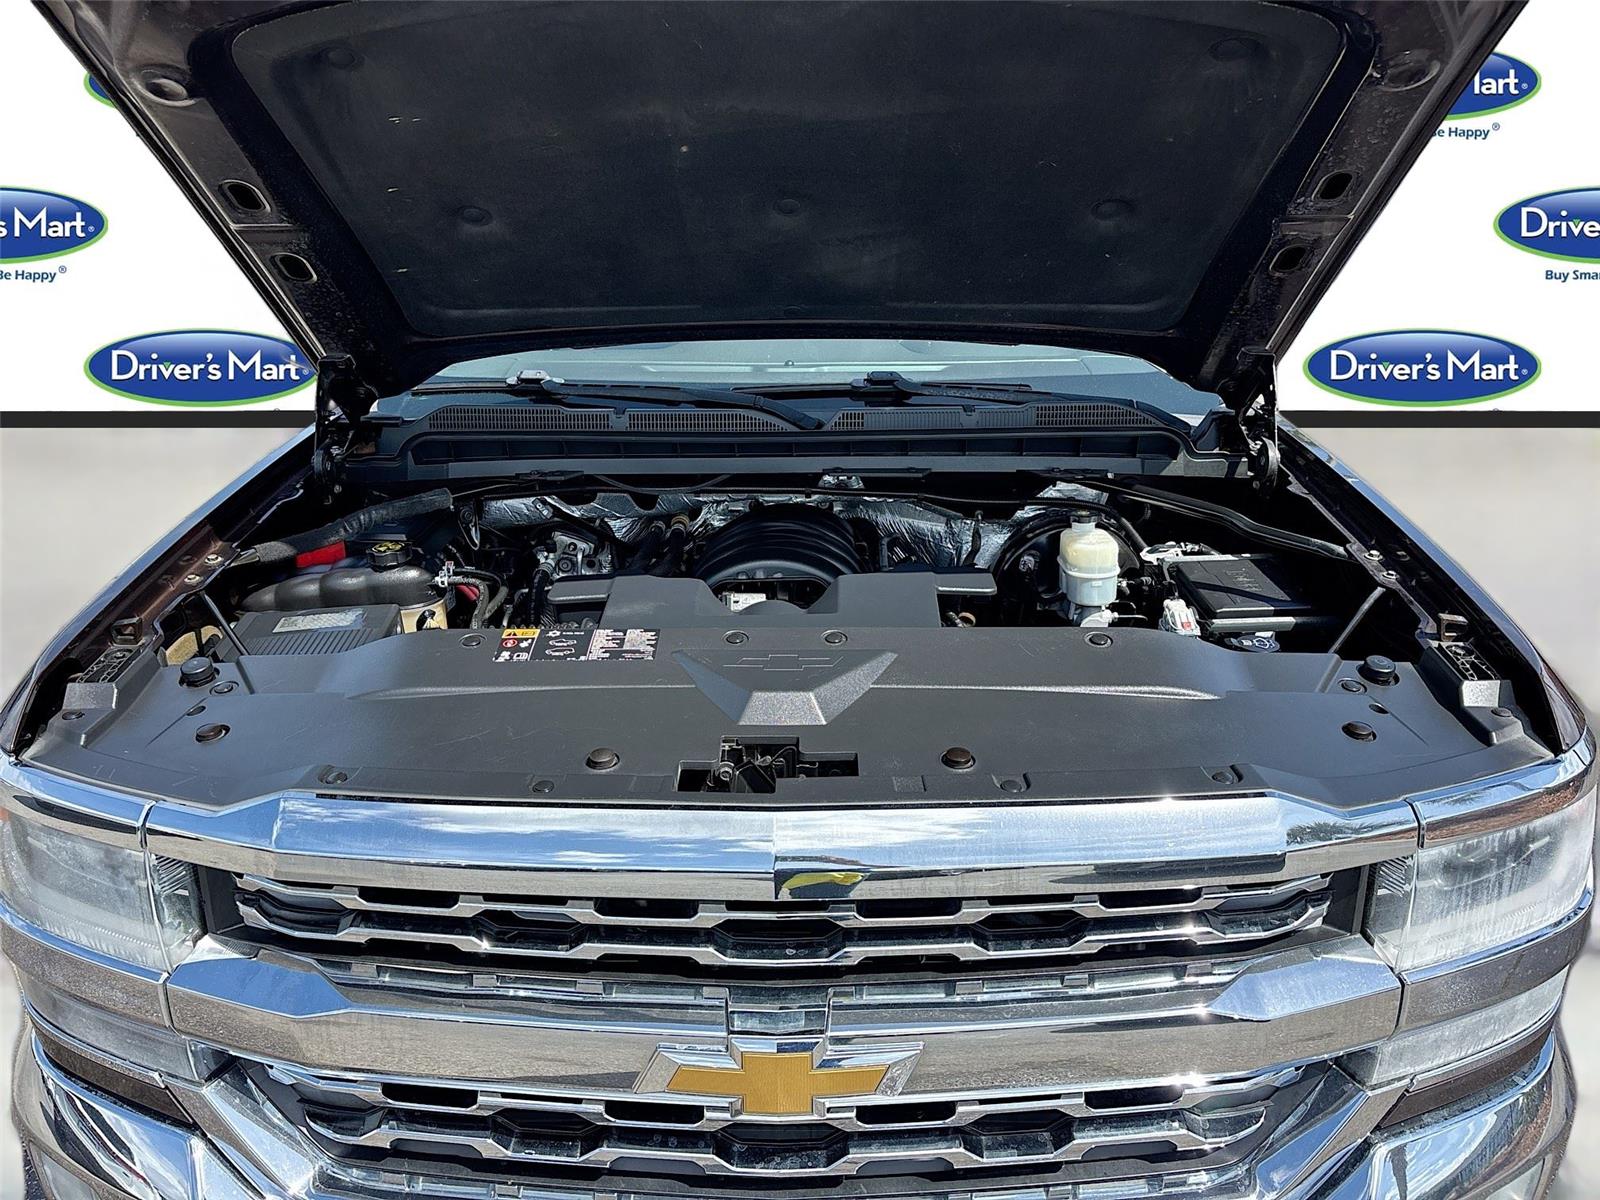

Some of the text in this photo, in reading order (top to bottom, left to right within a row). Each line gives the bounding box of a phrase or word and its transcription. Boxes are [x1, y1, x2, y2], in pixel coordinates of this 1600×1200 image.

[1448, 127, 1490, 140] Happy
[13, 206, 86, 238] Mart
[15, 270, 57, 283] Happy
[1545, 269, 1600, 283] Buy Sma
[110, 349, 300, 381] Driver's Mart
[1329, 349, 1519, 381] Driver's Mart
